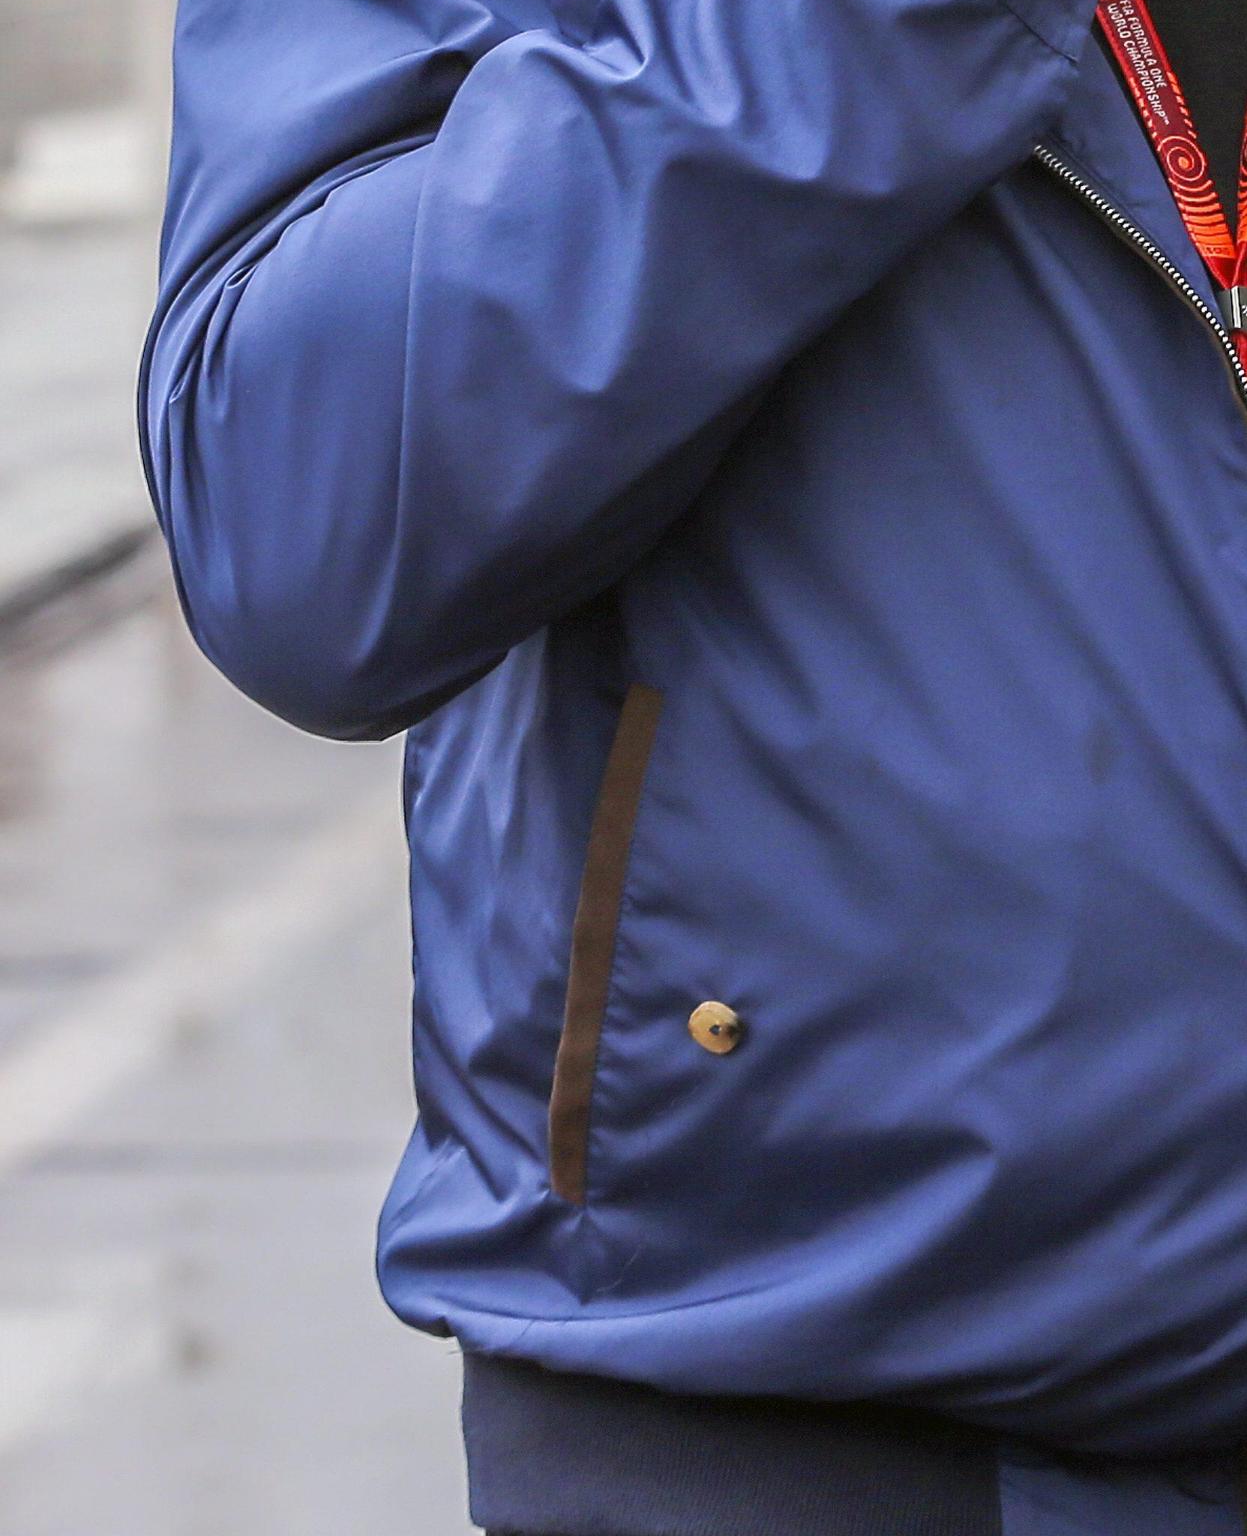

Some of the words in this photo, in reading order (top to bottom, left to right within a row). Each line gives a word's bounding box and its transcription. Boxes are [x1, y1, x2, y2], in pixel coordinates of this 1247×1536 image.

[1107, 3, 1132, 39] WORLD
[1119, 0, 1135, 15] FIA
[1128, 16, 1157, 65] FORMULA
[1150, 68, 1167, 88] ONE
